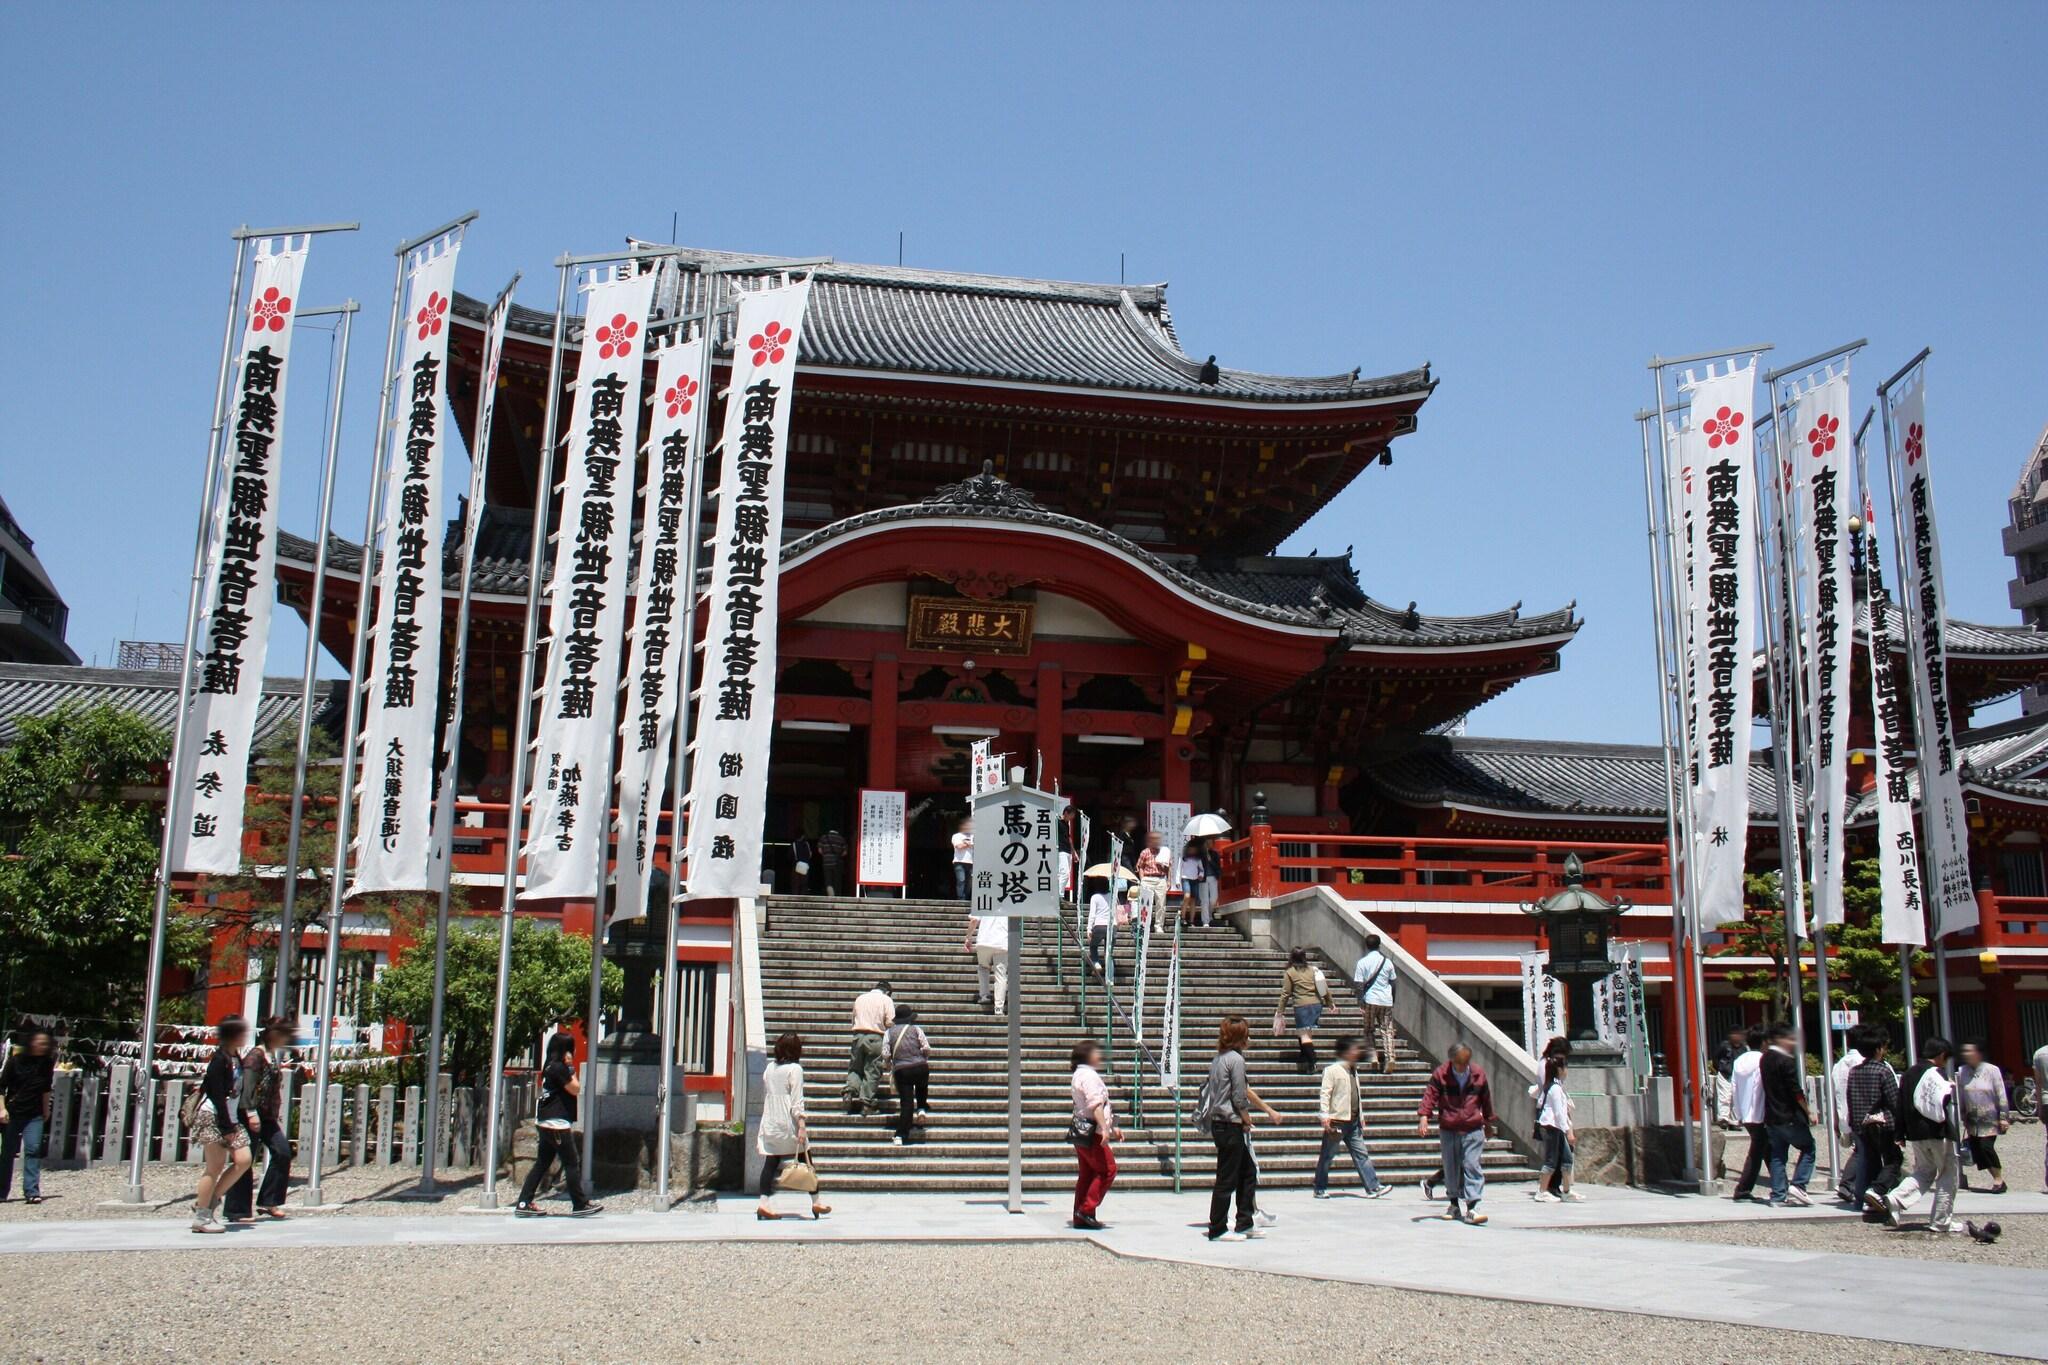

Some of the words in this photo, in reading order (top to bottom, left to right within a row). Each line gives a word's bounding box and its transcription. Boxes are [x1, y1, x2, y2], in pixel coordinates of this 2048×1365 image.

[933, 612, 1013, 640] 大悲殿
[997, 804, 1033, 904] 馬の塔
[1037, 809, 1052, 891] 五月十八日
[1896, 832, 1920, 910] 西川長寿
[977, 871, 993, 910] 當山
[1542, 975, 1556, 1031] 命地蔵尊
